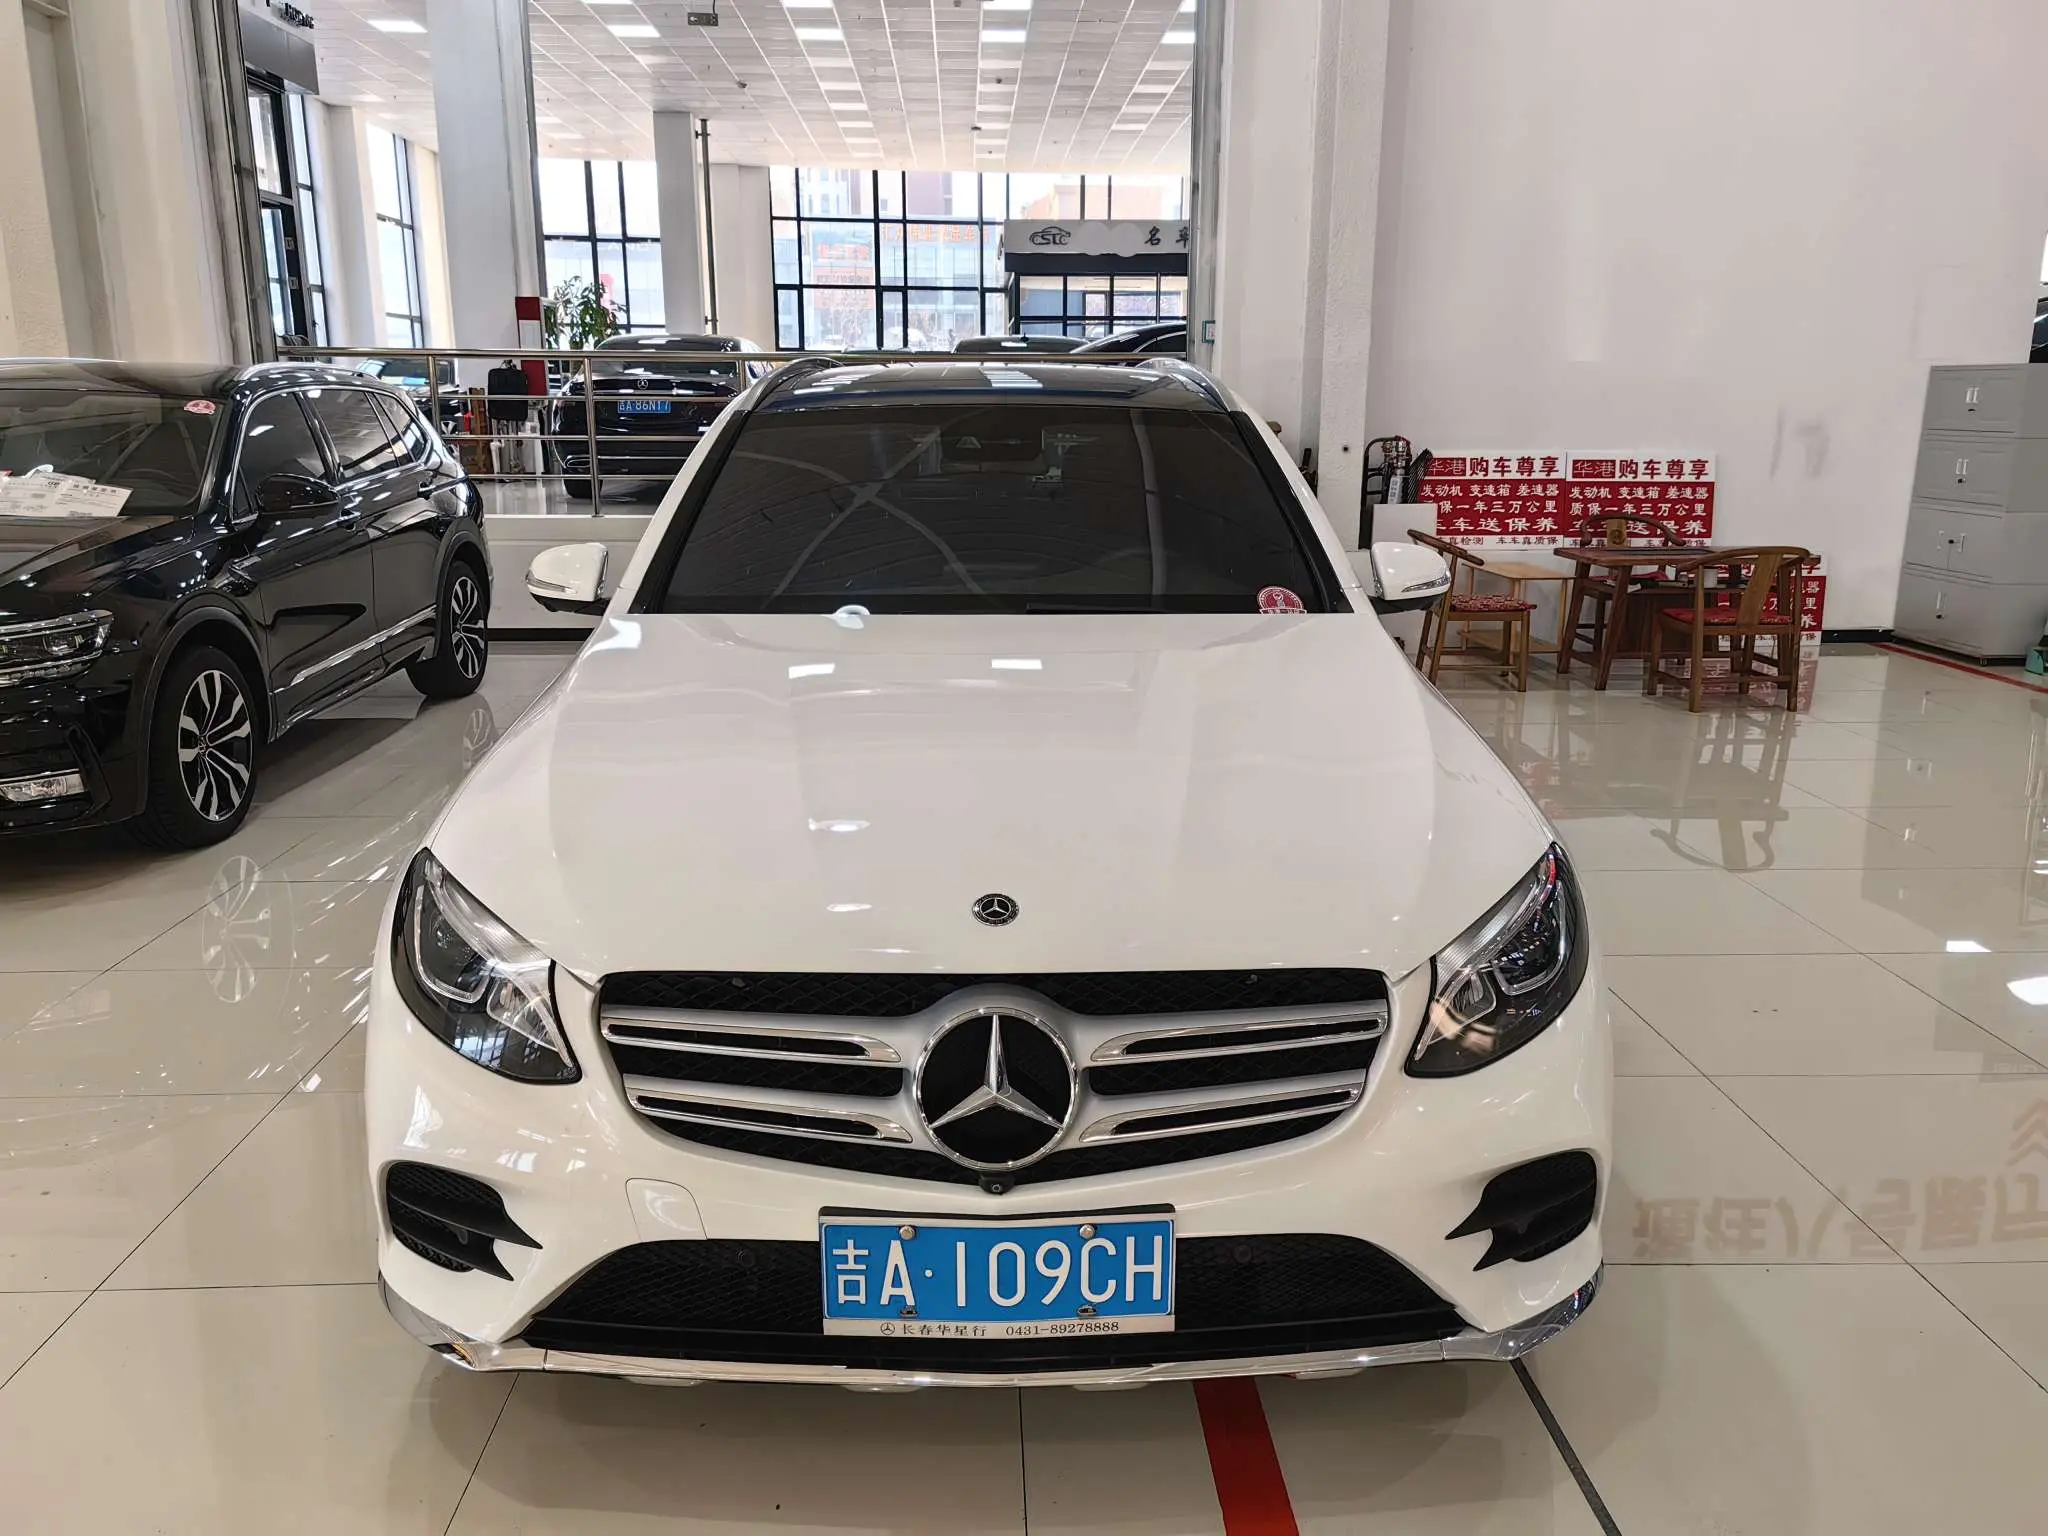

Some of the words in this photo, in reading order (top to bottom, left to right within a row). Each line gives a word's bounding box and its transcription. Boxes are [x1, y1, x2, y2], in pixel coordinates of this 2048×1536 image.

[1469, 456, 1559, 477] 购车尊享
[1573, 461, 1615, 477] 华港
[1618, 459, 1709, 480] 购车尊享
[1421, 484, 1463, 497] 发动机
[1469, 484, 1511, 497] 变速箱
[1516, 483, 1559, 497] 差速器
[1569, 486, 1612, 499] 发动机
[1617, 486, 1660, 499] 变速箱
[1665, 486, 1709, 499] 差速器
[1424, 499, 1557, 514] 保一年三万公里
[1569, 502, 1707, 516] 质保一年三万公里
[832, 1235, 1163, 1307] 吉A·109CH
[903, 1323, 987, 1337] 长春华星行
[1005, 1321, 1120, 1336] 0431-89278888
